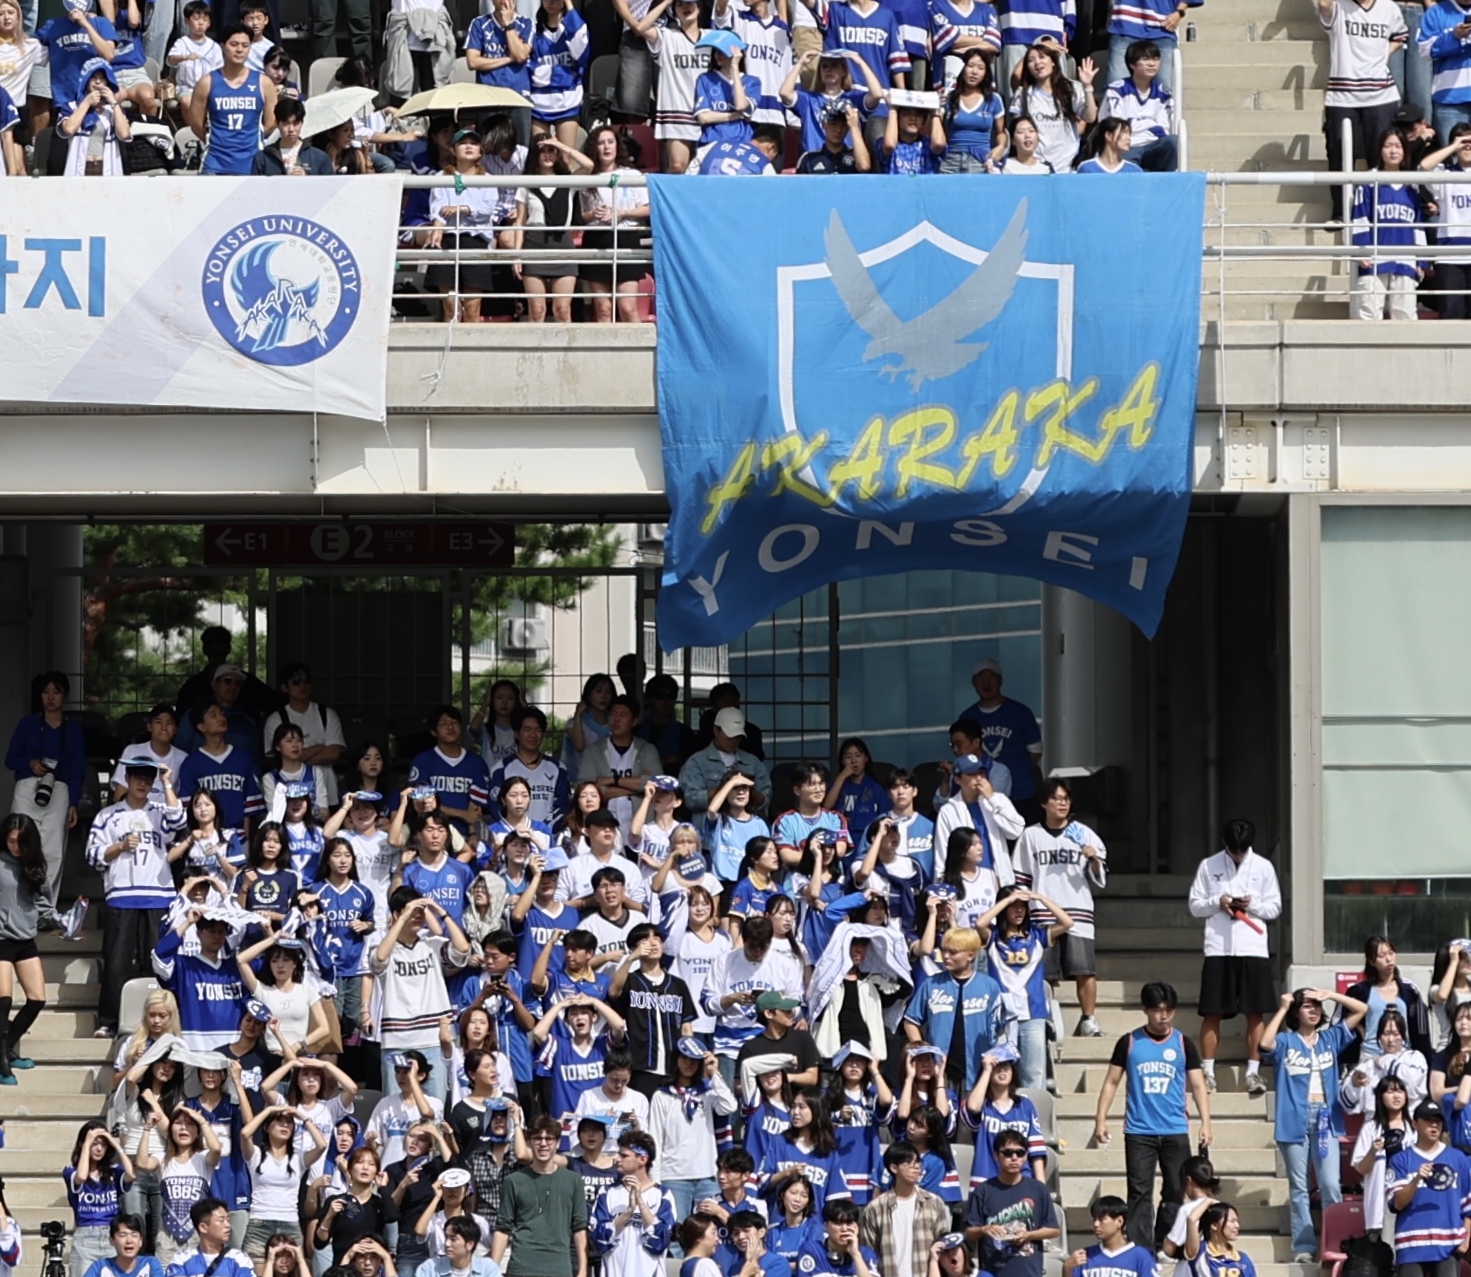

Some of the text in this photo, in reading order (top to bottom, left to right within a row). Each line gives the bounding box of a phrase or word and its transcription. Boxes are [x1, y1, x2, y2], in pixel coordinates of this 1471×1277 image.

[215, 97, 256, 109] YONSEI
[228, 114, 243, 129] 17
[206, 218, 357, 293] YONSEI UNIVERSITY
[702, 361, 1160, 536] AKARAKA
[244, 532, 270, 551] E1
[383, 529, 416, 539] BLOCK
[448, 533, 473, 551] E3
[688, 519, 1148, 616] YONSEI
[1137, 1060, 1176, 1076] YONSEI
[1144, 1077, 1169, 1094] 137
[163, 1176, 206, 1187] YONSEI
[165, 1185, 201, 1200] 1885
